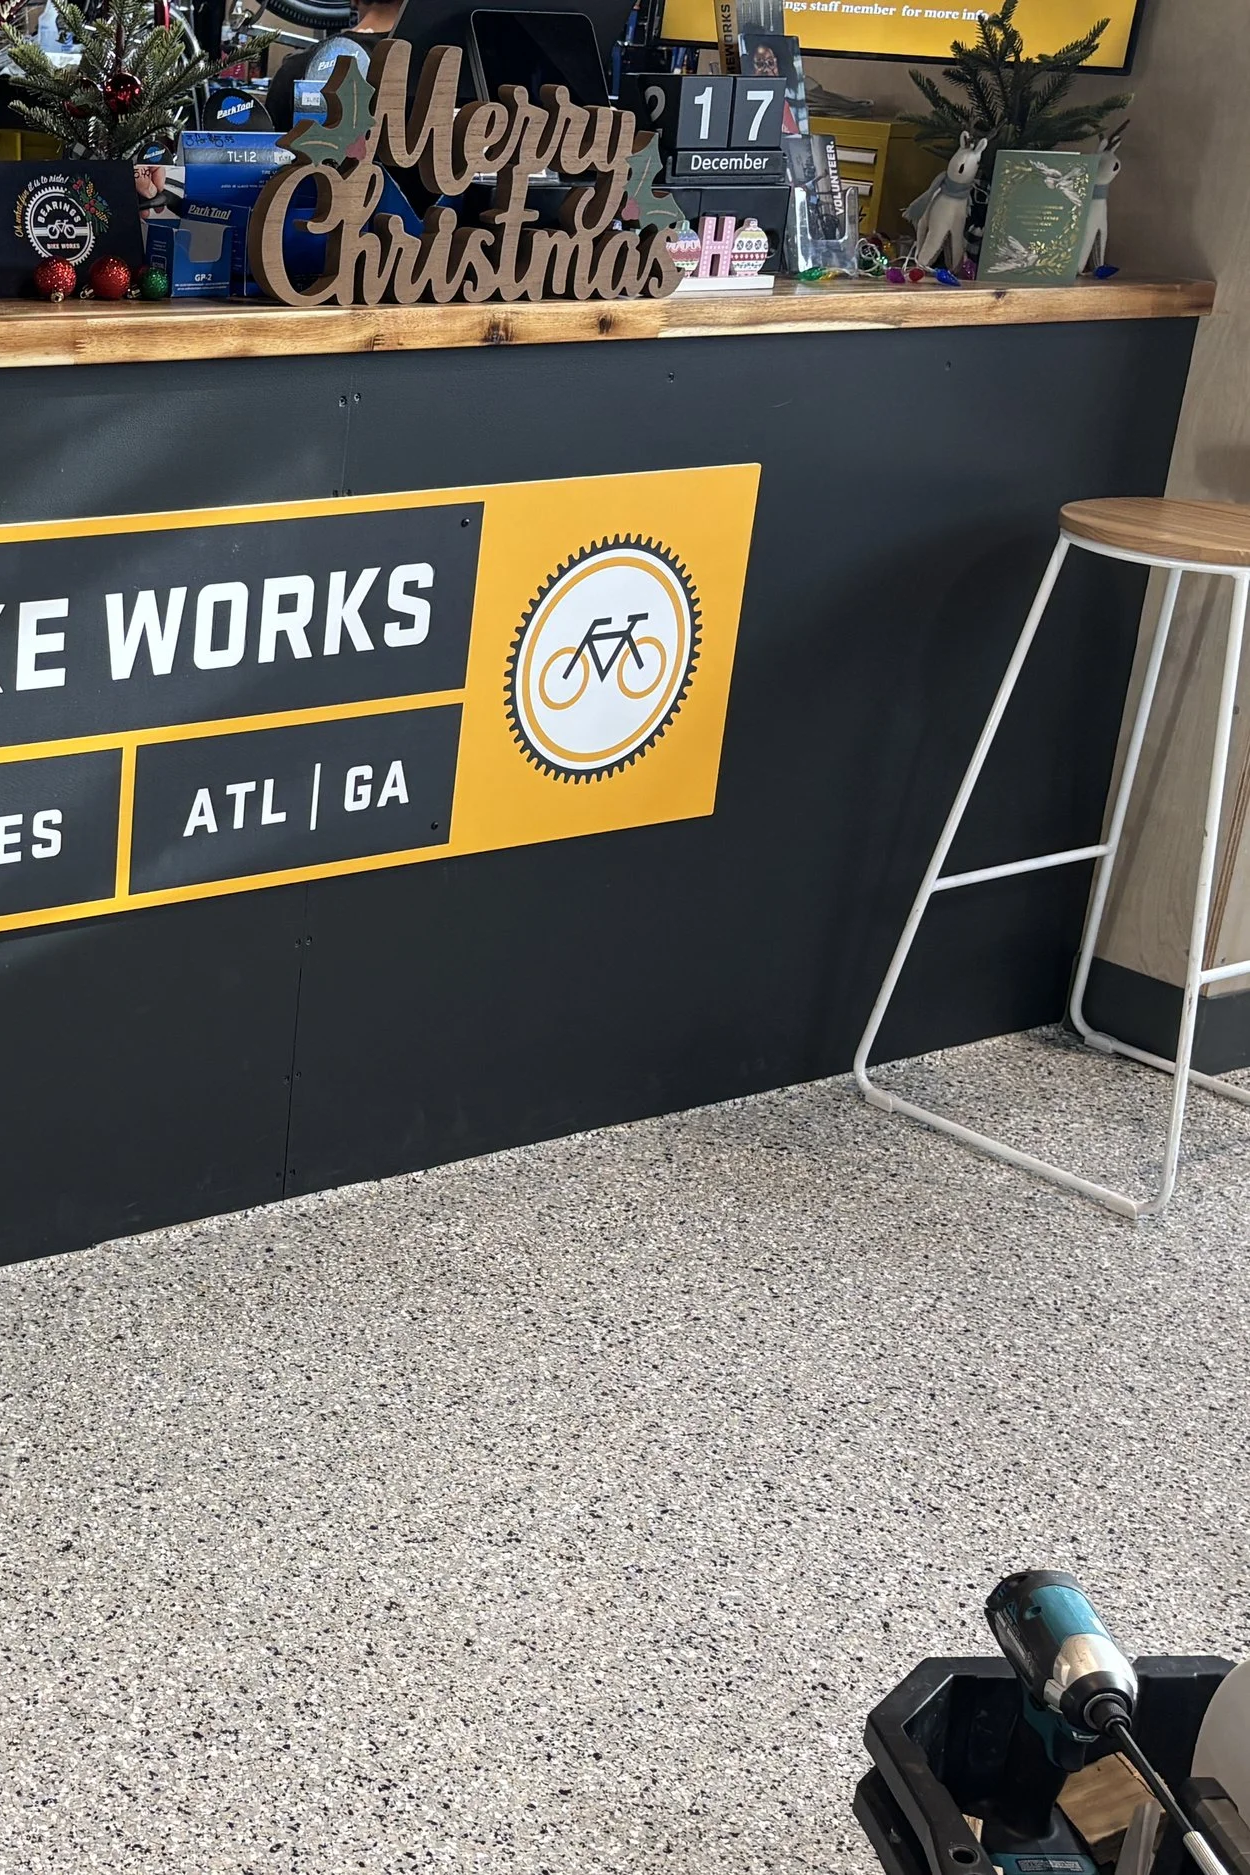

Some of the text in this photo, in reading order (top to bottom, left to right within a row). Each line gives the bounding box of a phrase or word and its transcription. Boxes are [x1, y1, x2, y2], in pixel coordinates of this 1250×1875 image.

[810, 1, 840, 13] staff
[842, 4, 896, 16] member
[902, 6, 922, 17] for
[924, 9, 959, 20] more
[362, 39, 636, 239] Merry
[690, 153, 769, 171] December
[37, 201, 81, 223] BEARINGS
[827, 140, 845, 216] VOLUNTEER.
[255, 161, 685, 306] Christmas
[194, 273, 213, 282] GP-2
[105, 563, 435, 681] WORKS
[183, 760, 410, 838] ATL GA
